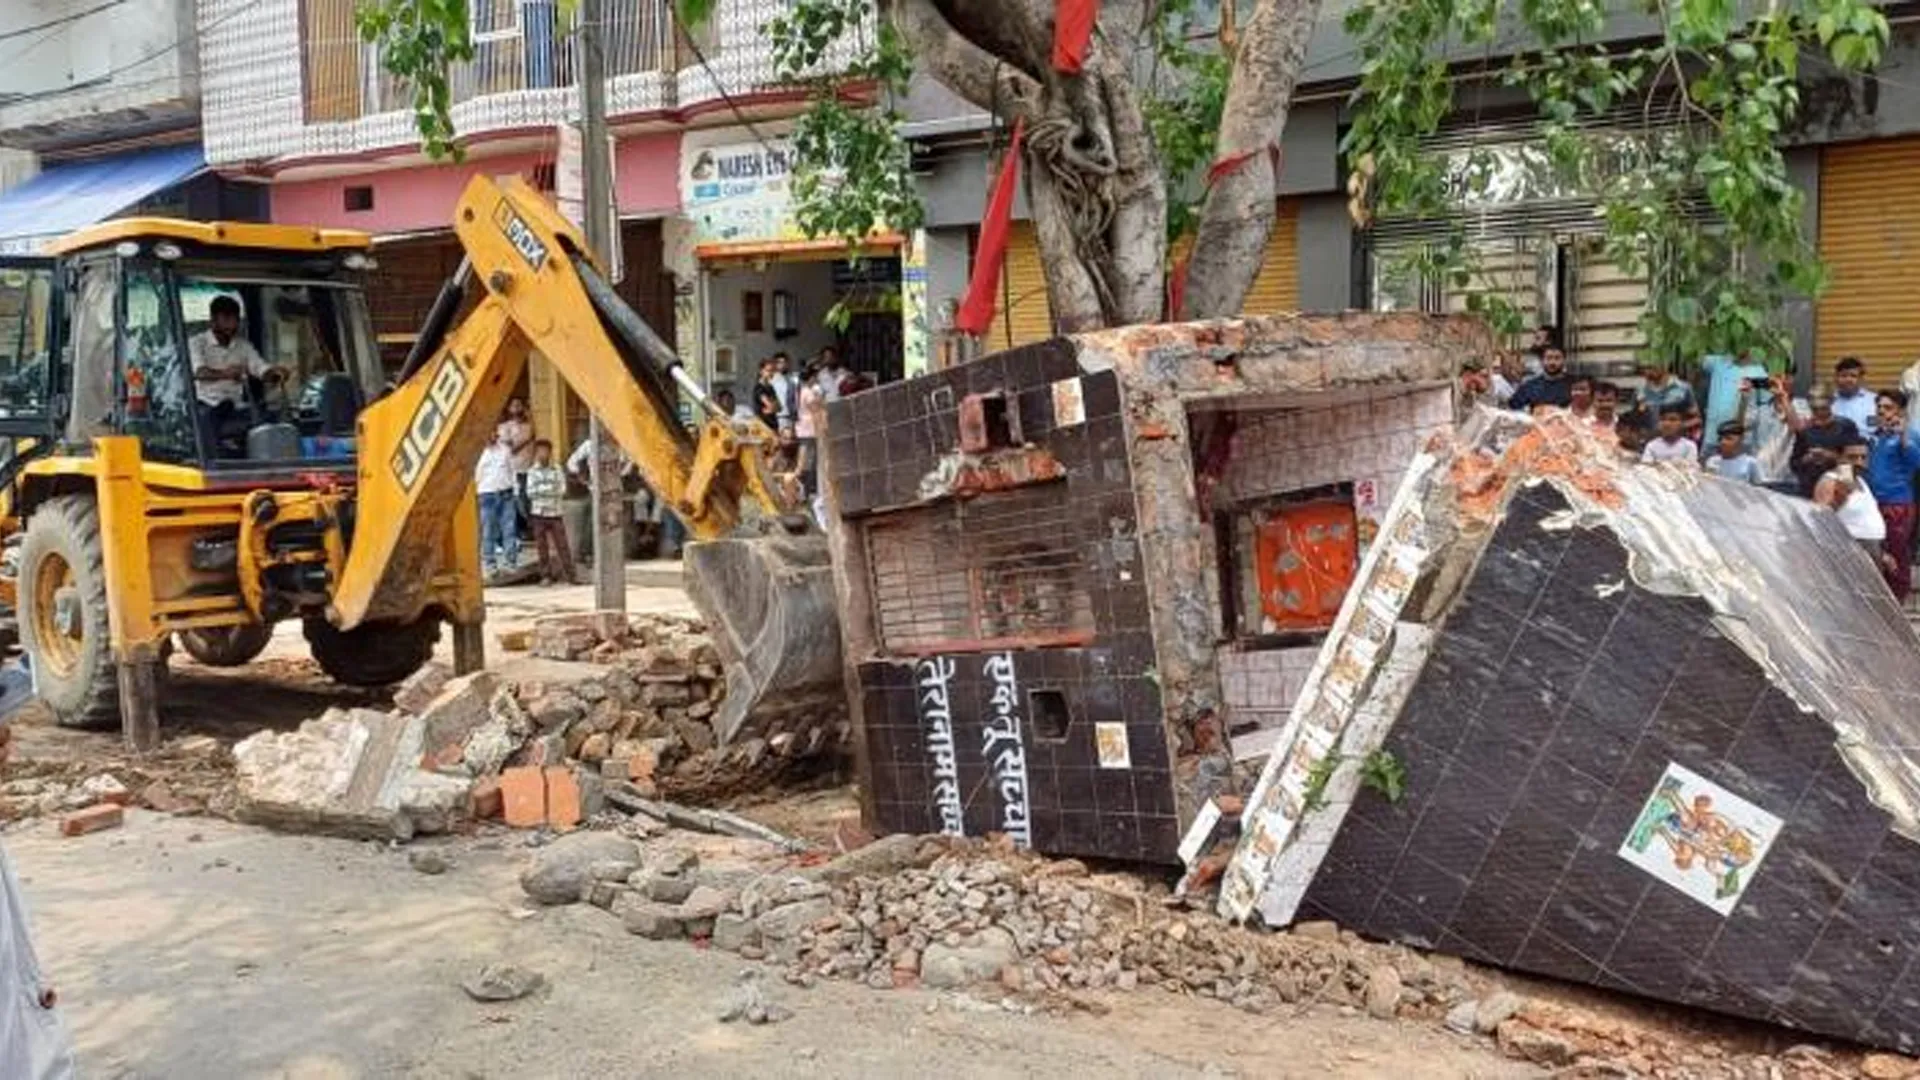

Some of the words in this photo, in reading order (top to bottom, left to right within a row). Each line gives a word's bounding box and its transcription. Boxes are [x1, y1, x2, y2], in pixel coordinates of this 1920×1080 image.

[718, 153, 763, 179] NARESH
[392, 358, 465, 487] JCB
[981, 716, 1022, 755] तू
